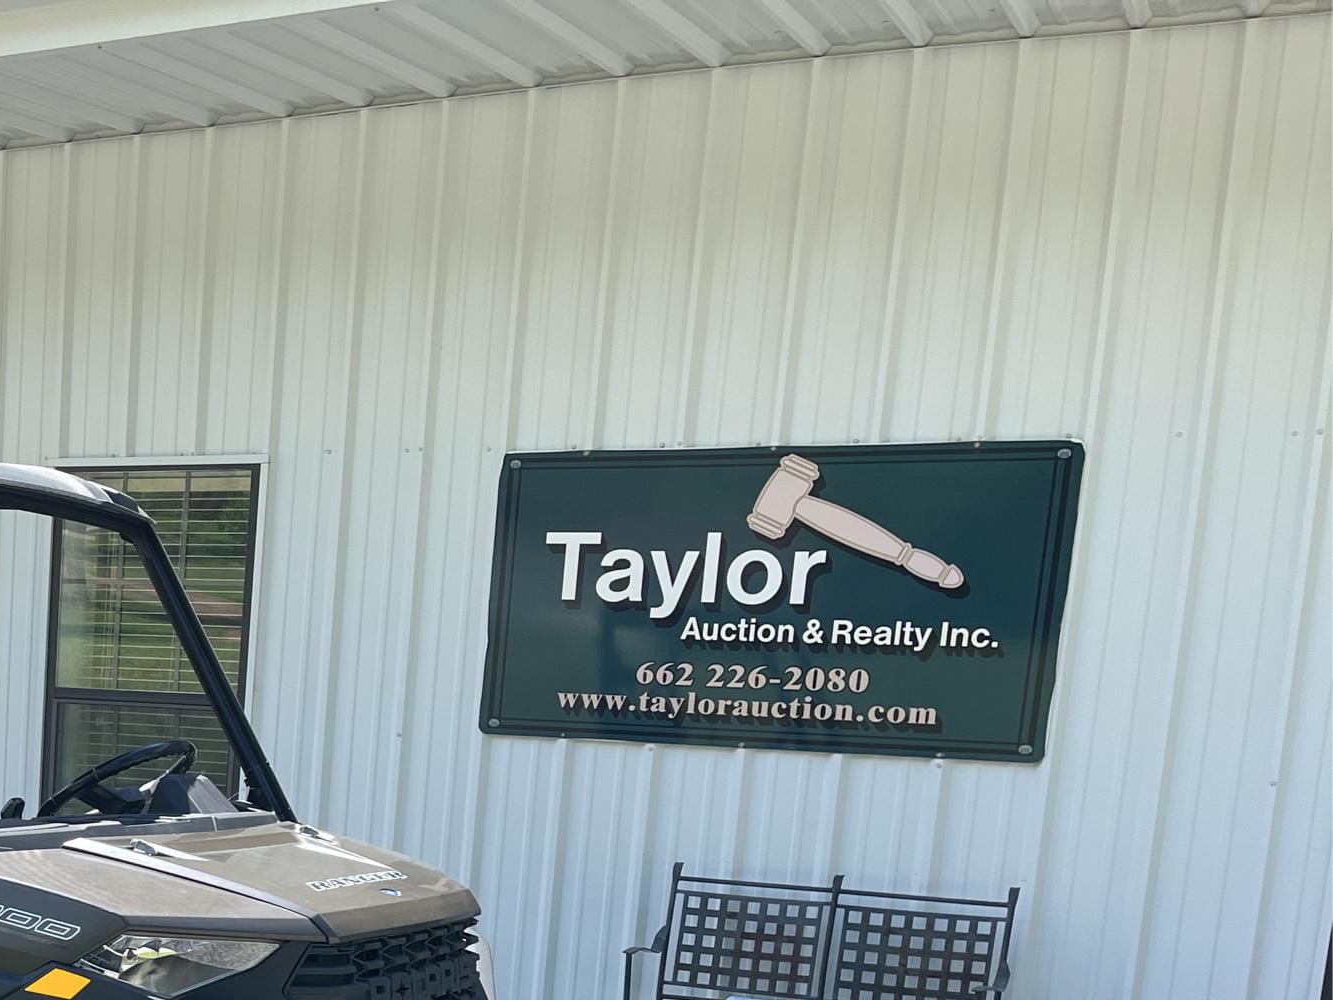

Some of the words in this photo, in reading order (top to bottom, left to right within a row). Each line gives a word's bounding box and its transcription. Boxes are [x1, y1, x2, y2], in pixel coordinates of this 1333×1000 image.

[545, 531, 827, 619] Taylor
[680, 616, 795, 645] Auction
[802, 620, 824, 645] &
[830, 620, 933, 651] Realty
[939, 622, 999, 649] Inc.
[636, 661, 694, 687] 662
[707, 663, 870, 694] 226-2080
[557, 690, 938, 726] www.taylorauction.com
[306, 870, 408, 892] RANGER
